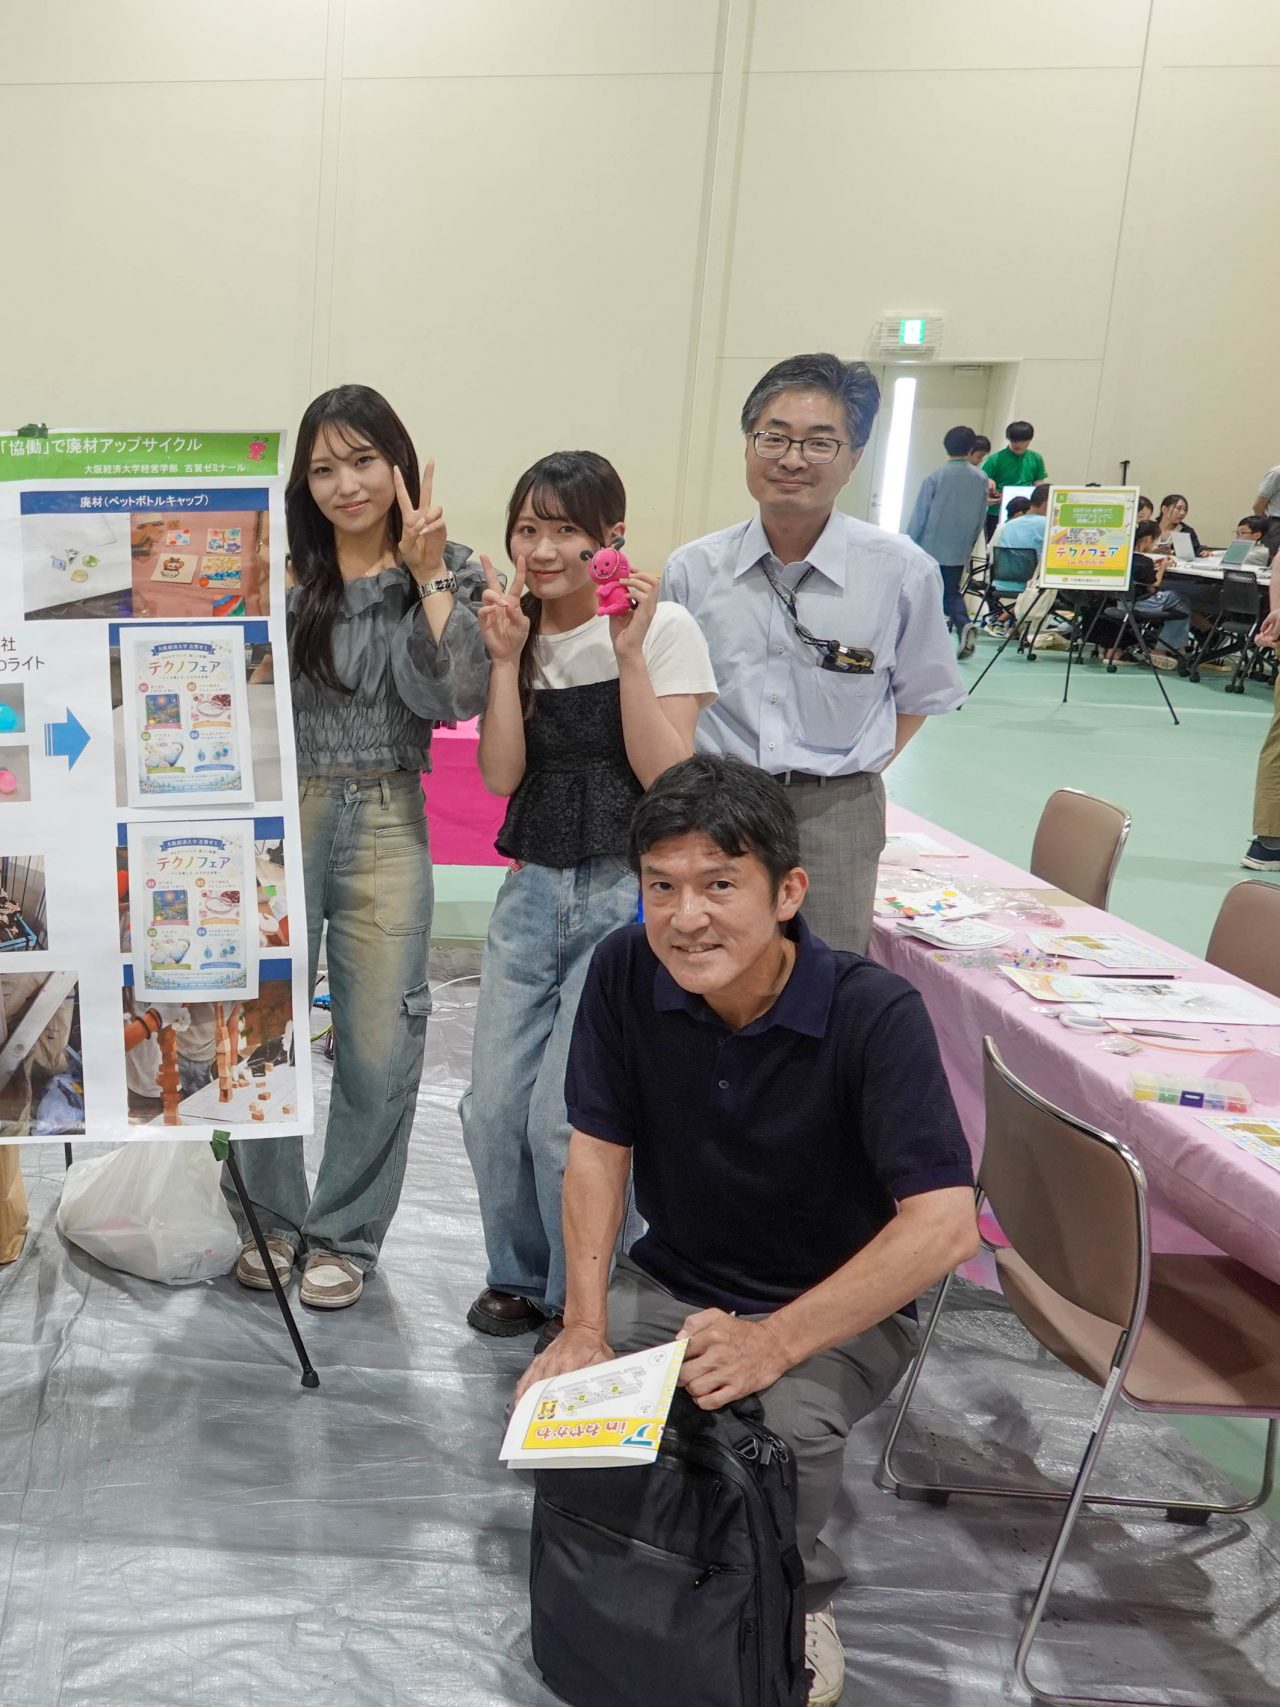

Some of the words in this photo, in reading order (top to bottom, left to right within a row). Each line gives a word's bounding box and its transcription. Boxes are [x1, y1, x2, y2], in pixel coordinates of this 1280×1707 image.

[84, 463, 179, 475] 大阪経済大学経営学部
[184, 463, 247, 474] 古賀ゼミナール
[1055, 546, 1120, 558] テクノフェア
[148, 660, 221, 676] テクノフェア
[156, 856, 231, 872] テクノフェア
[535, 1423, 601, 1440] ねやがわ
[605, 1421, 627, 1435] in
